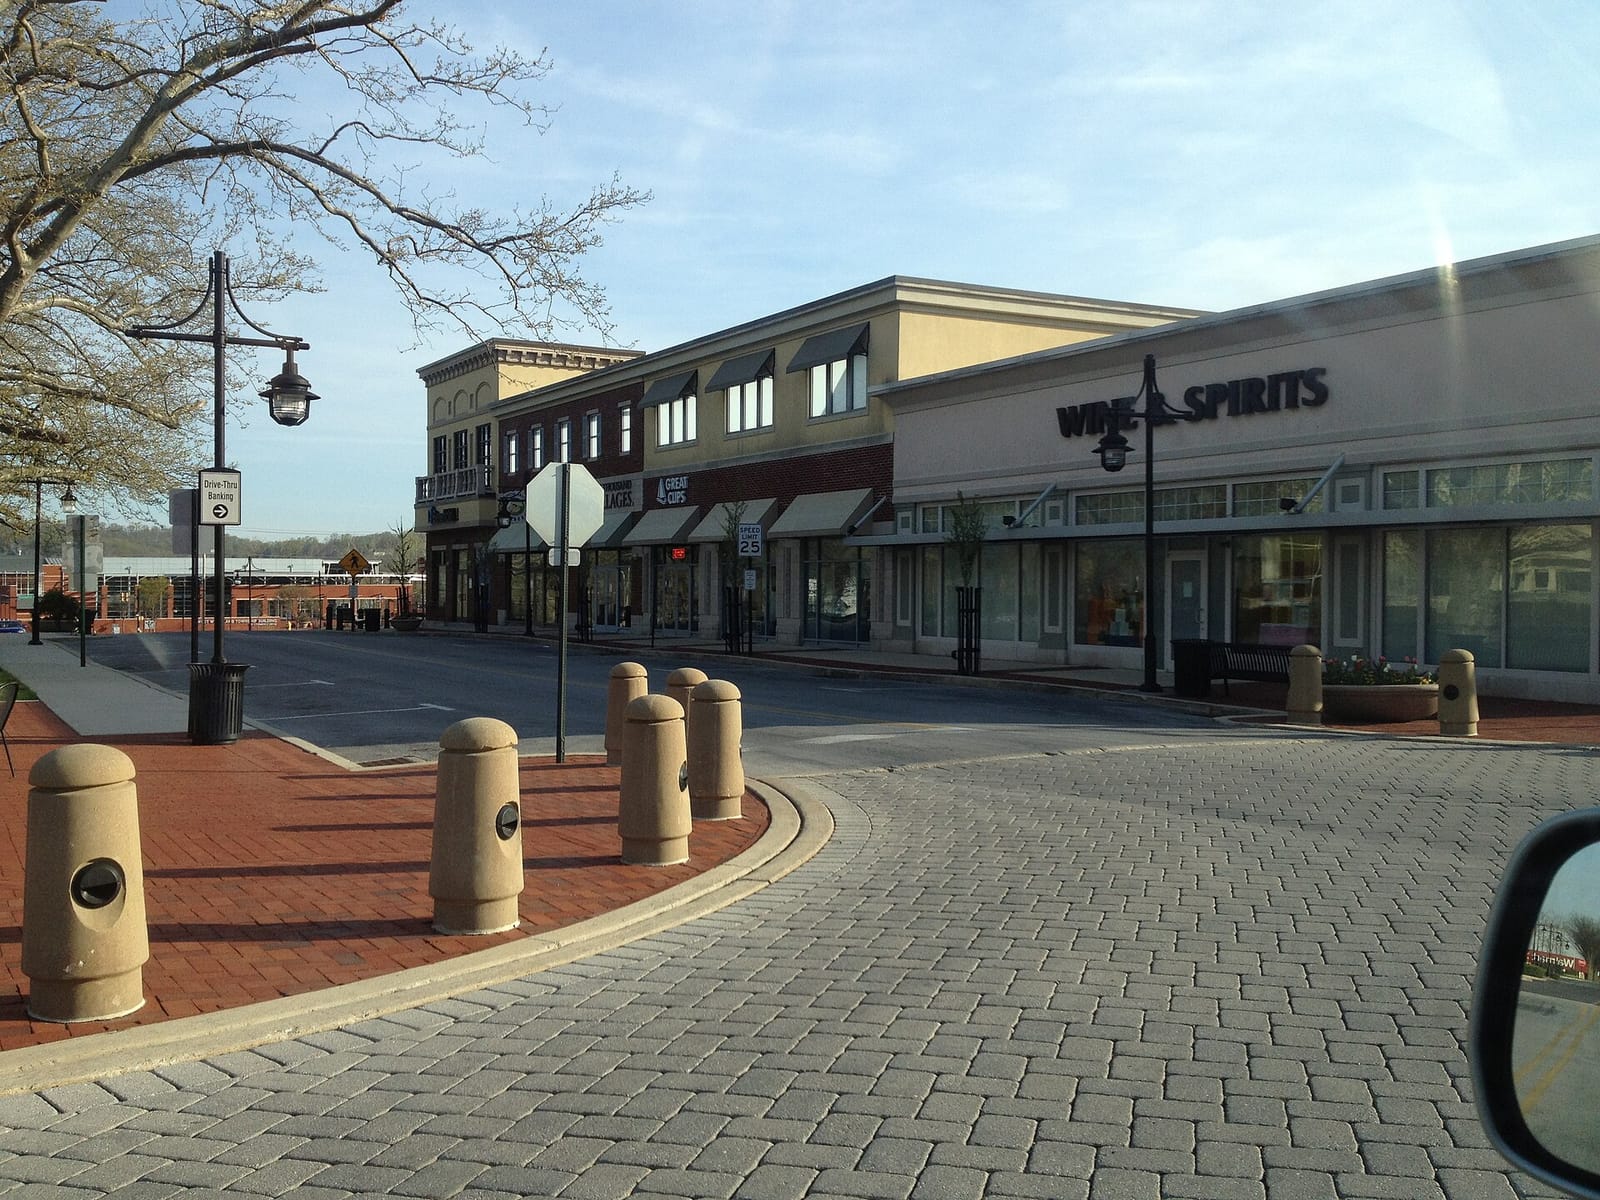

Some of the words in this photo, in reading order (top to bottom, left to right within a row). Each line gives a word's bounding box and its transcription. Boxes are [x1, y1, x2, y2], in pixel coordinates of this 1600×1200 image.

[1056, 396, 1138, 438] WINE
[1184, 367, 1329, 423] SPIRITS
[204, 480, 238, 489] Drive-Thru
[665, 476, 689, 490] GREAT
[208, 491, 234, 502] Banking
[667, 491, 687, 505] CUPS
[740, 541, 760, 553] 25
